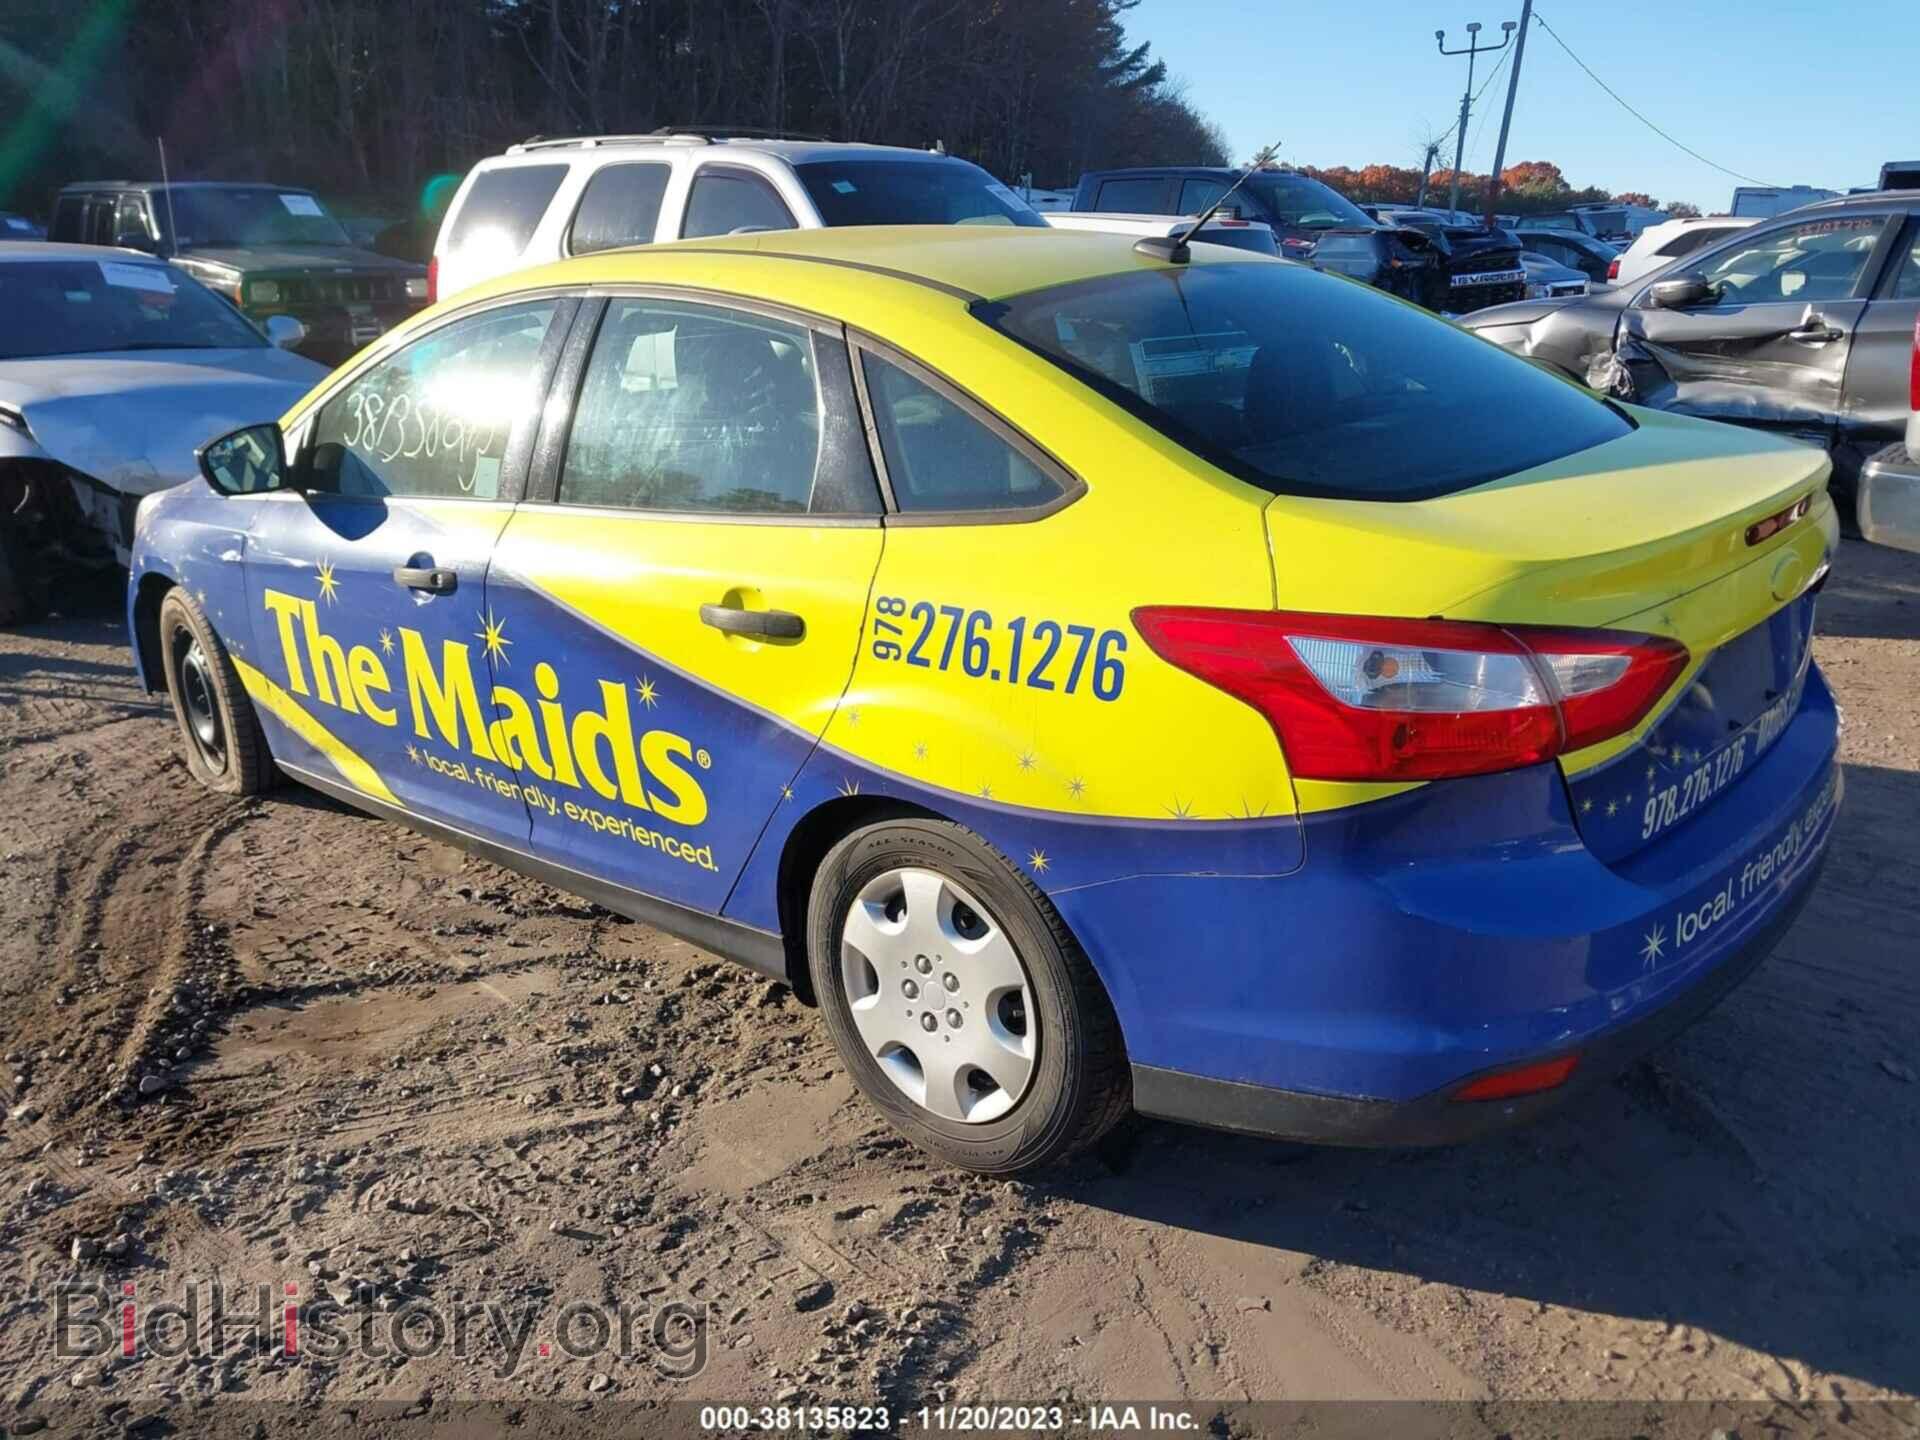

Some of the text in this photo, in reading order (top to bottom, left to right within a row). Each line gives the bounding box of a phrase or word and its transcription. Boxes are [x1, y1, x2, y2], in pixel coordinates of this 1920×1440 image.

[264, 588, 397, 726] The
[873, 596, 906, 661] 978
[906, 601, 1128, 702] 276.1276
[423, 750, 720, 872] local. friendly. experienced.
[1642, 735, 1747, 839] 978.276.1276
[1676, 876, 1736, 948] local.
